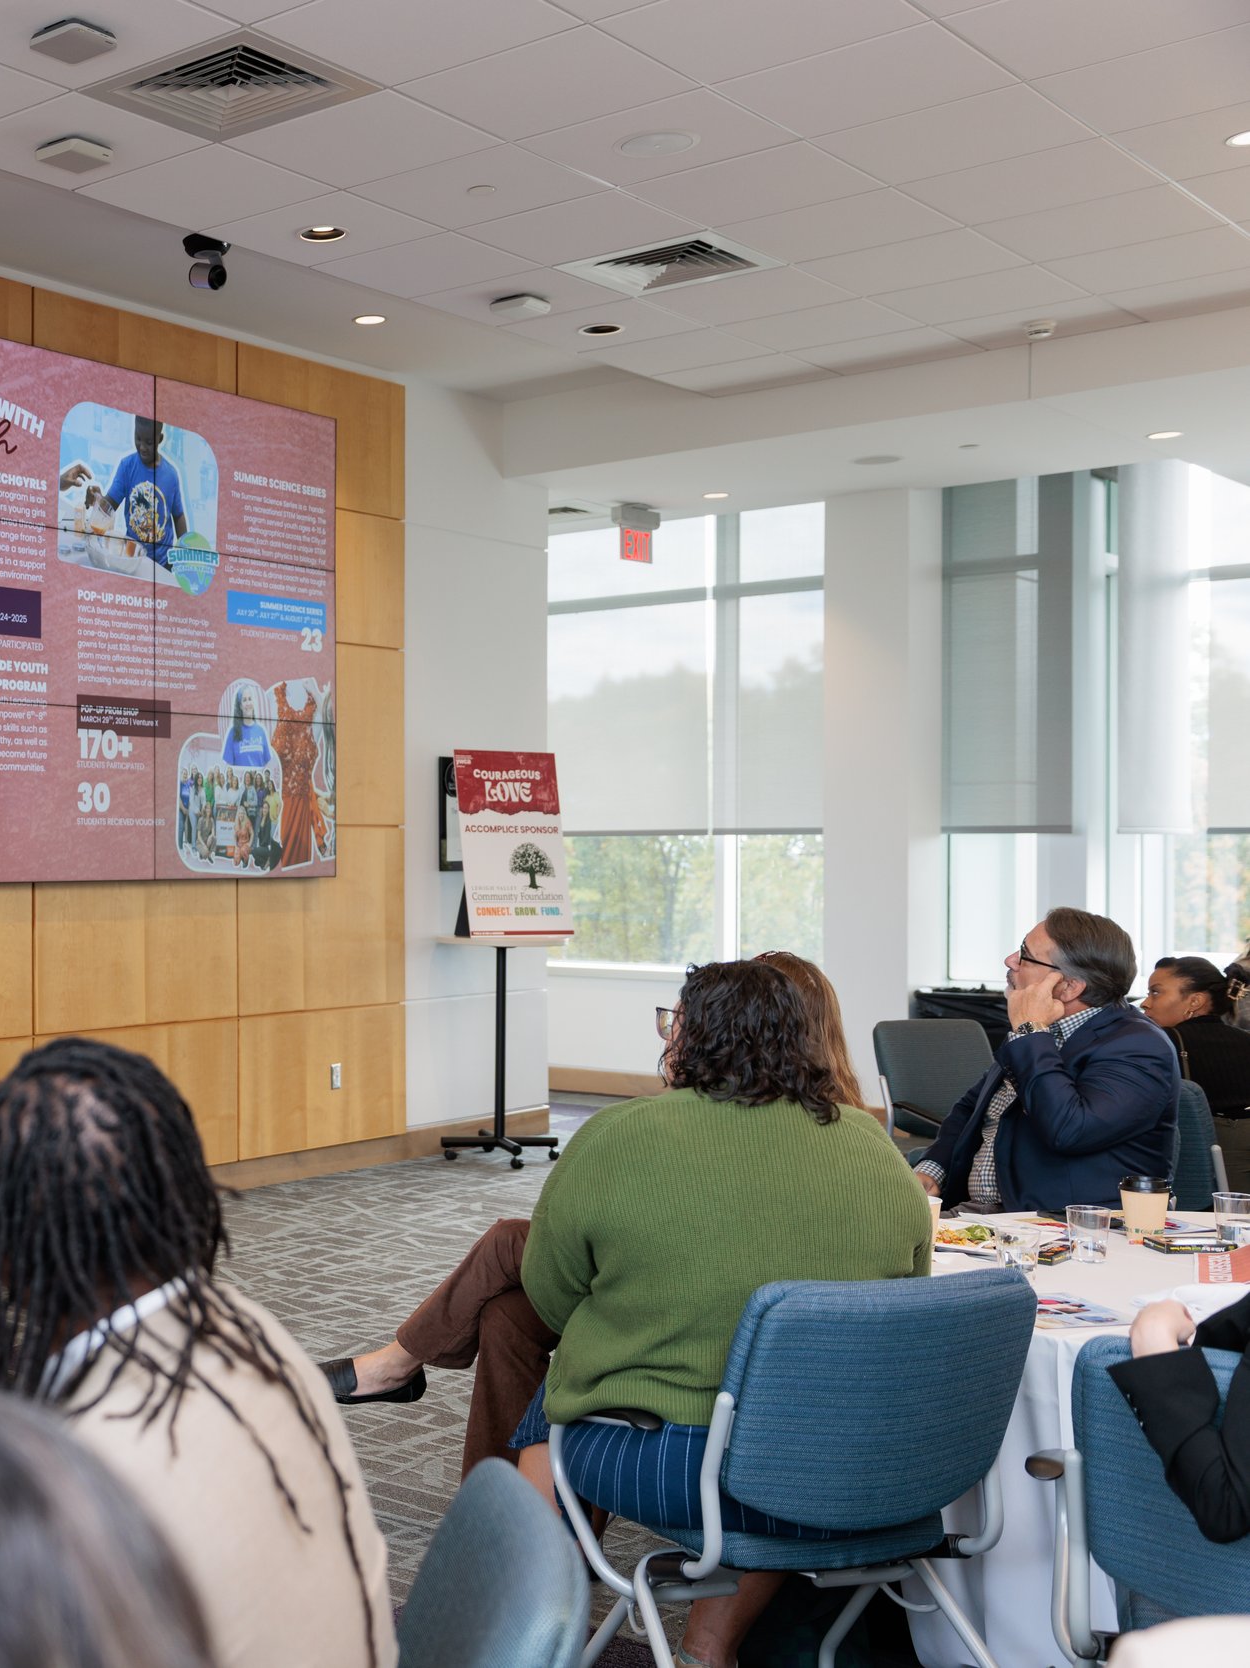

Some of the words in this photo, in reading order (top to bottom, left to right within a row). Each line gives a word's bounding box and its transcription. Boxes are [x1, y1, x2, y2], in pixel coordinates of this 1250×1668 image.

[234, 471, 267, 487] SUMMER
[269, 478, 301, 493] SCIENCE
[302, 485, 326, 498] SERIES
[8, 505, 30, 517] young
[32, 509, 45, 517] girls
[20, 532, 36, 542] from
[18, 546, 37, 556] series
[624, 529, 651, 561] EXIT
[168, 550, 218, 566] SUMMER
[19, 561, 45, 570] support
[78, 589, 114, 603] POP-UP
[116, 594, 142, 607] PROM
[144, 598, 168, 610] SHOP
[301, 627, 322, 652] 23
[14, 661, 48, 674] YOUTH
[20, 724, 38, 733] such
[78, 729, 132, 760] 170+
[26, 750, 47, 760] future
[77, 760, 105, 769] STUDENTS
[107, 761, 144, 770] PARTICIPATED
[473, 769, 541, 780] COURAGEOUS
[78, 782, 110, 812] 30
[485, 781, 532, 802] LOVE
[465, 825, 519, 834] ACCOMPLICE
[521, 826, 558, 834] SPONSOR
[472, 892, 518, 901] Community
[520, 891, 563, 900] Foundation
